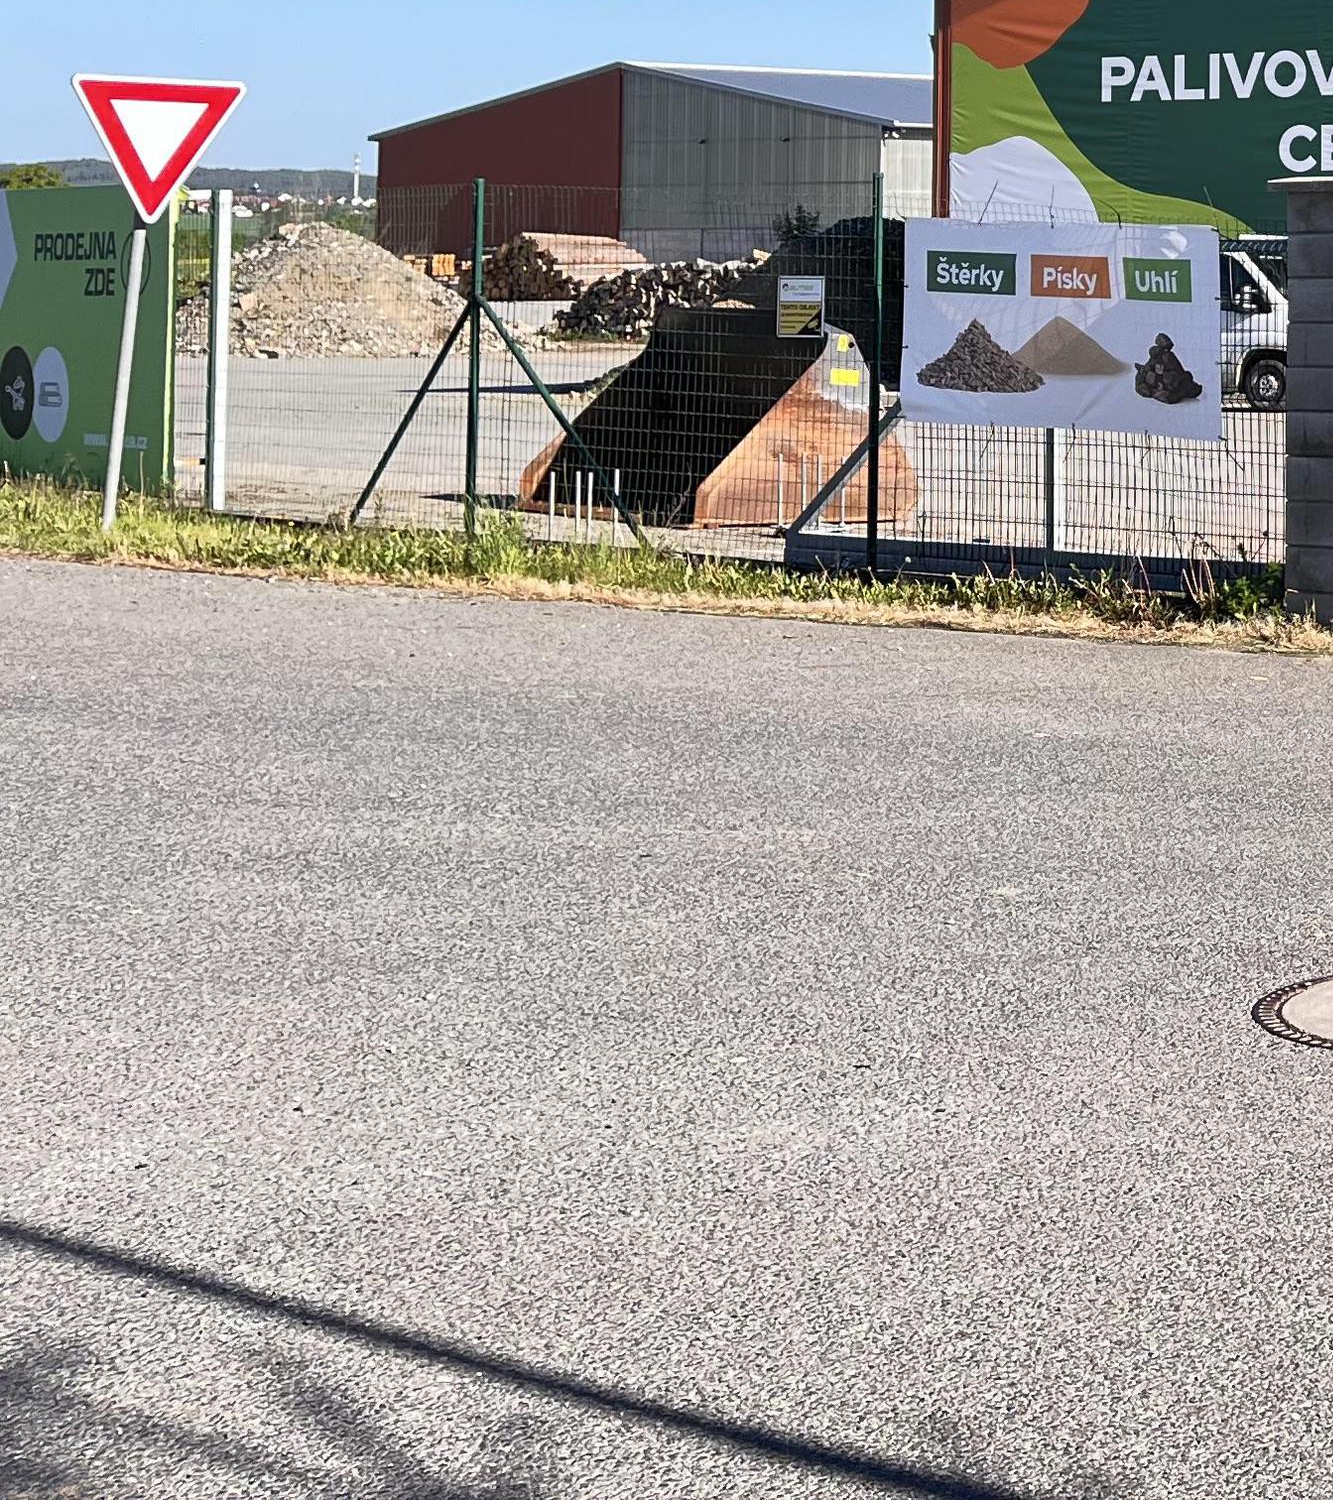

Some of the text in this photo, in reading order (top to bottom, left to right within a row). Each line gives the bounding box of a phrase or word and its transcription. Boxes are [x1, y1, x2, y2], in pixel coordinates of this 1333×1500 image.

[34, 231, 117, 261] PRODEJNA
[84, 267, 115, 296] ZDE
[936, 256, 1178, 295] Štěrky Písky Uhlí
